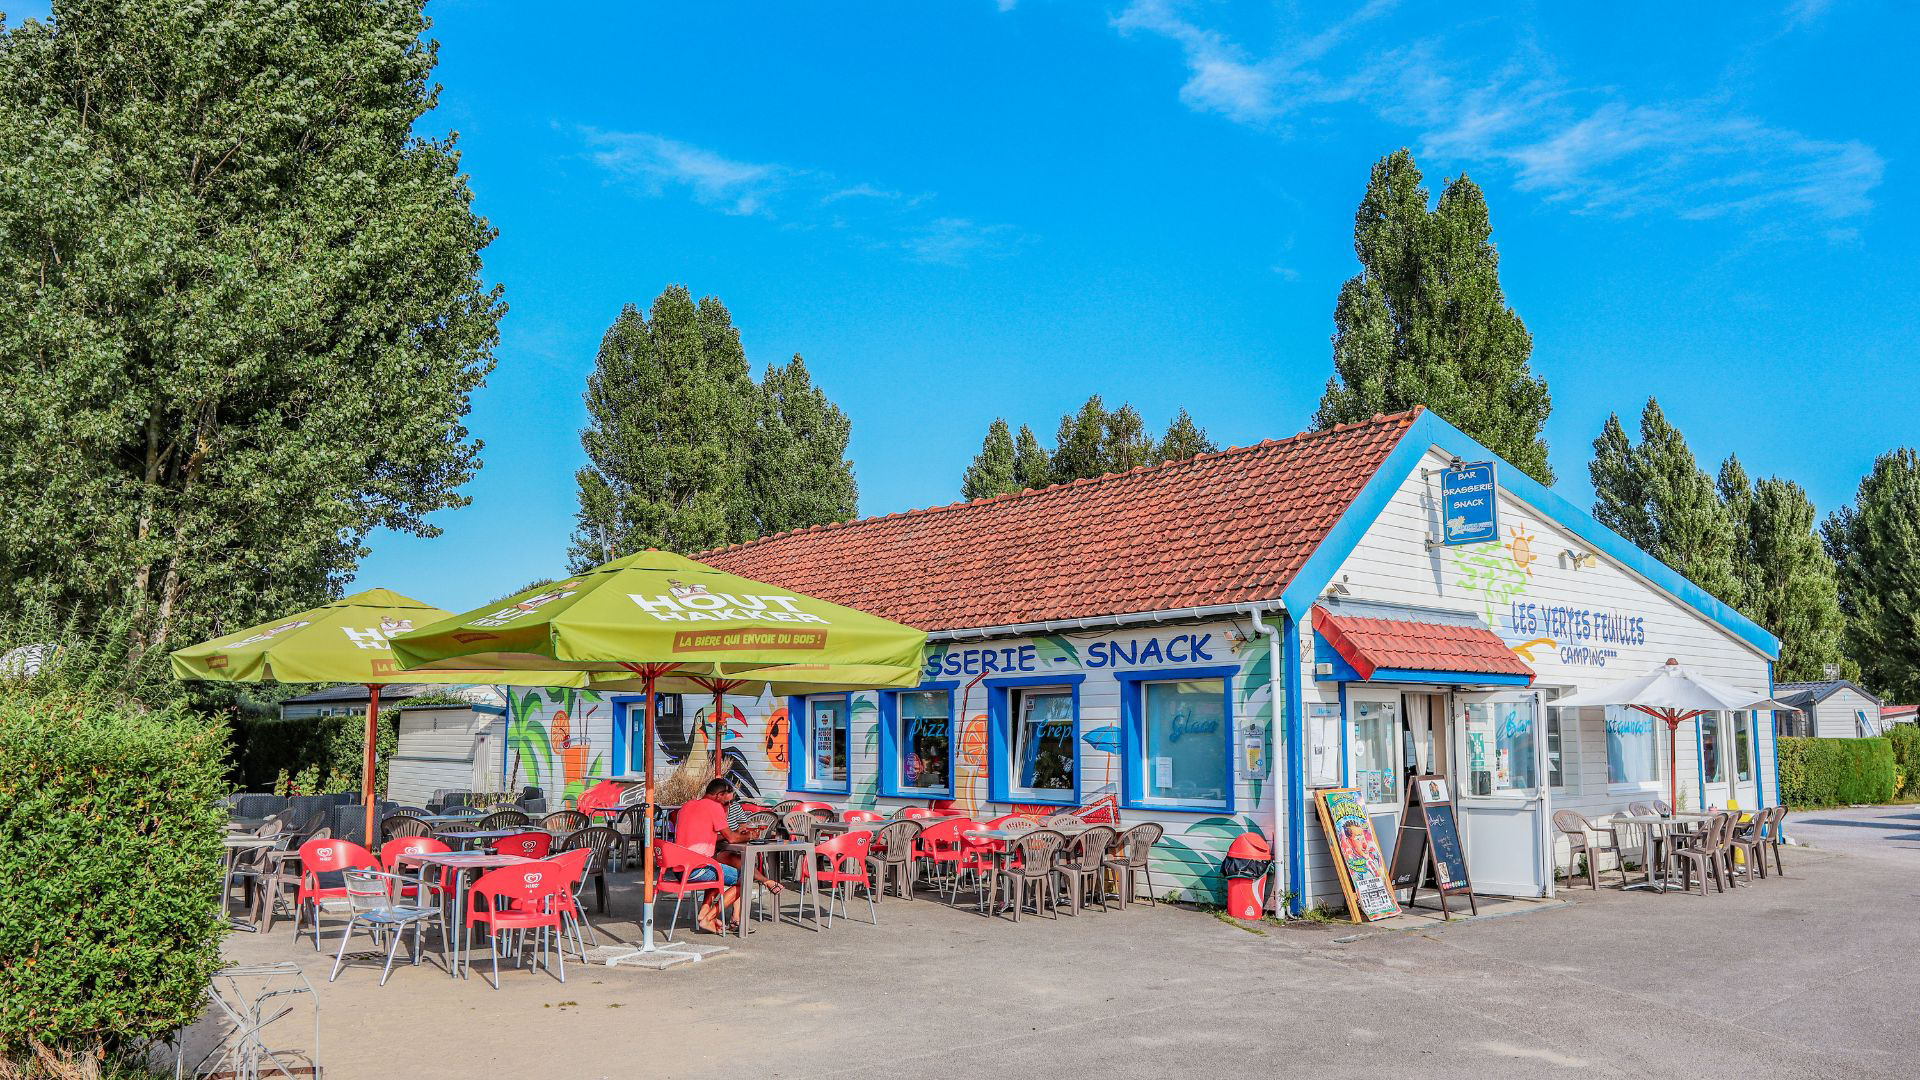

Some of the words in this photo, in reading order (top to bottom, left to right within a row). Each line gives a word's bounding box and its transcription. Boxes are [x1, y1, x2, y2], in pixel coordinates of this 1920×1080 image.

[1457, 471, 1477, 481] BAR
[1442, 482, 1494, 496] BRASSERIE
[1453, 498, 1485, 509] SNACK
[627, 592, 803, 612] HOUT
[649, 608, 832, 625] HAKKER
[1511, 600, 1537, 635] LES
[1541, 603, 1591, 645] VERTES
[1593, 607, 1645, 646] FEUILLES
[679, 636, 692, 648] LA
[695, 633, 721, 646] BIÈRE
[723, 633, 740, 645] QUI
[742, 633, 775, 645] ENVOIE
[778, 633, 791, 644] DU
[793, 633, 815, 644] BOIS
[925, 644, 1036, 676] SSERIE
[1086, 633, 1213, 668] SNACK
[1506, 711, 1531, 738] Bar
